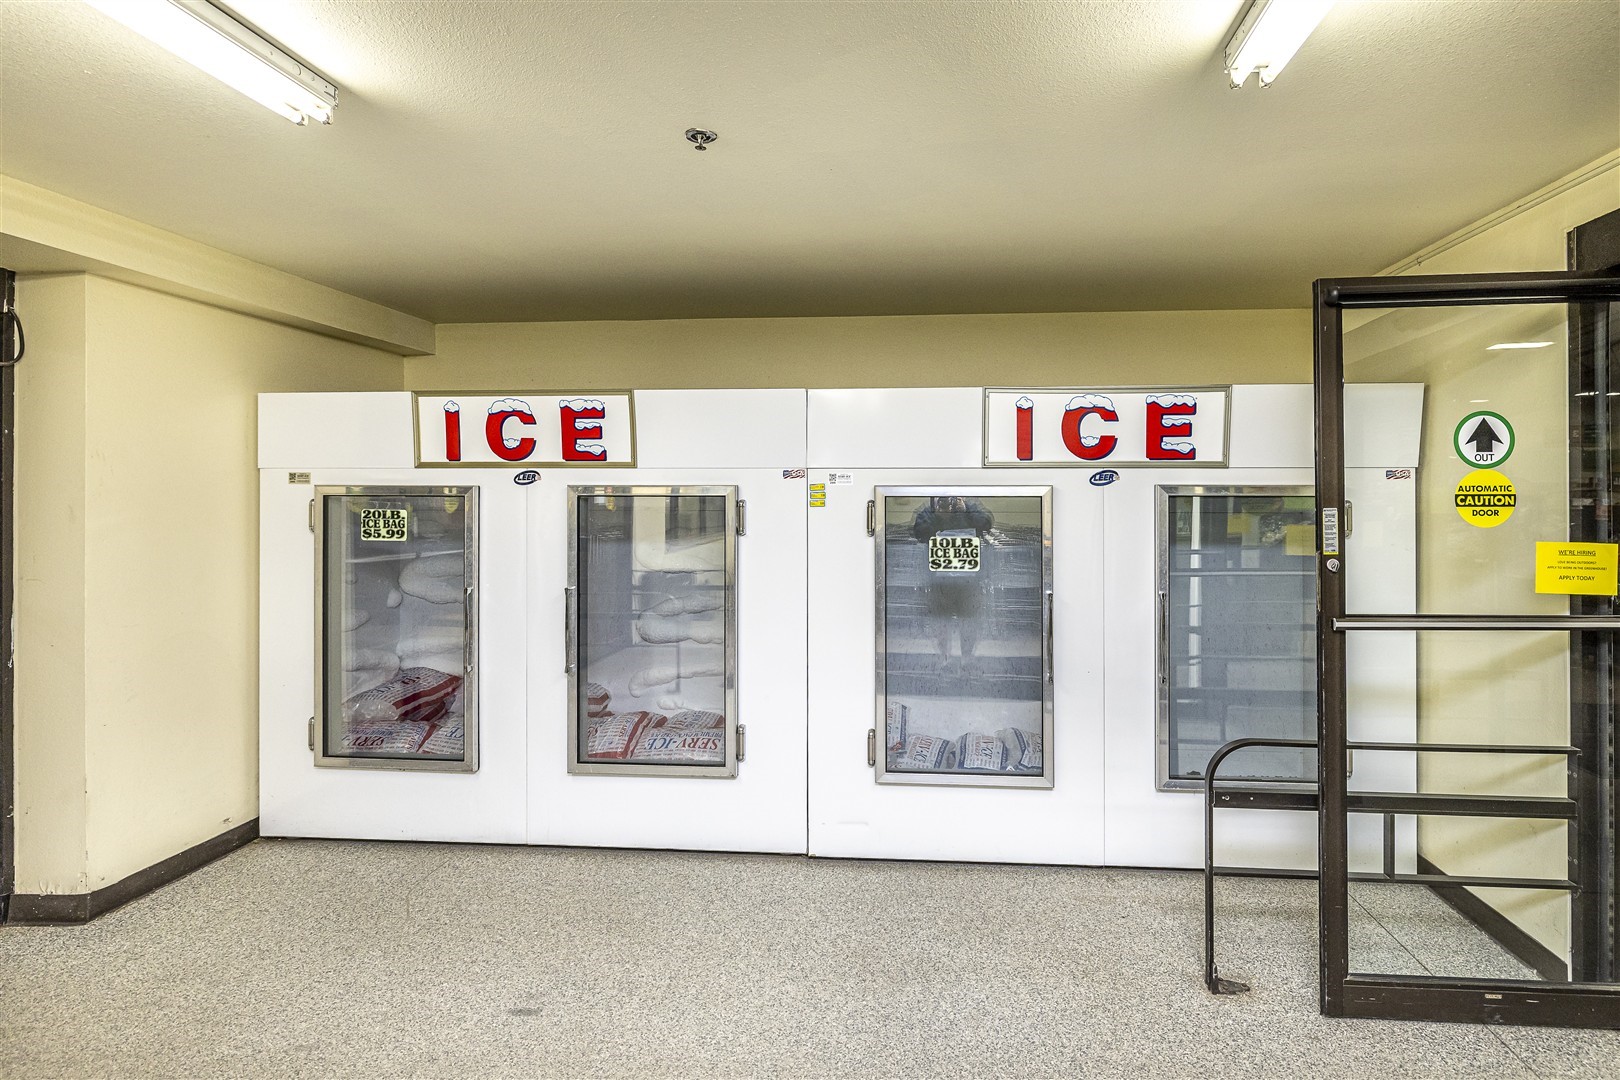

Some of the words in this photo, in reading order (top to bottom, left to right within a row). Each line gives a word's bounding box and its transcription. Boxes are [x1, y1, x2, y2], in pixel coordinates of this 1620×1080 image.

[443, 398, 607, 461] ICE
[1015, 393, 1197, 461] ICE
[1474, 453, 1495, 462] OUT
[517, 473, 537, 481] LEER
[1093, 473, 1115, 481] LEER
[1457, 485, 1513, 493] AUTOMATIC
[1456, 495, 1515, 506] CAUTION
[362, 509, 406, 520] 20LB.
[1472, 509, 1500, 517] DOOR
[362, 519, 381, 529] ICE
[382, 519, 406, 529] BAG
[362, 529, 406, 540] $5.99
[930, 537, 979, 549] 10LB.
[930, 548, 951, 559] ICE
[953, 548, 979, 559] BAG
[930, 559, 979, 570] $2.79
[643, 737, 721, 750] SERV-ICE
